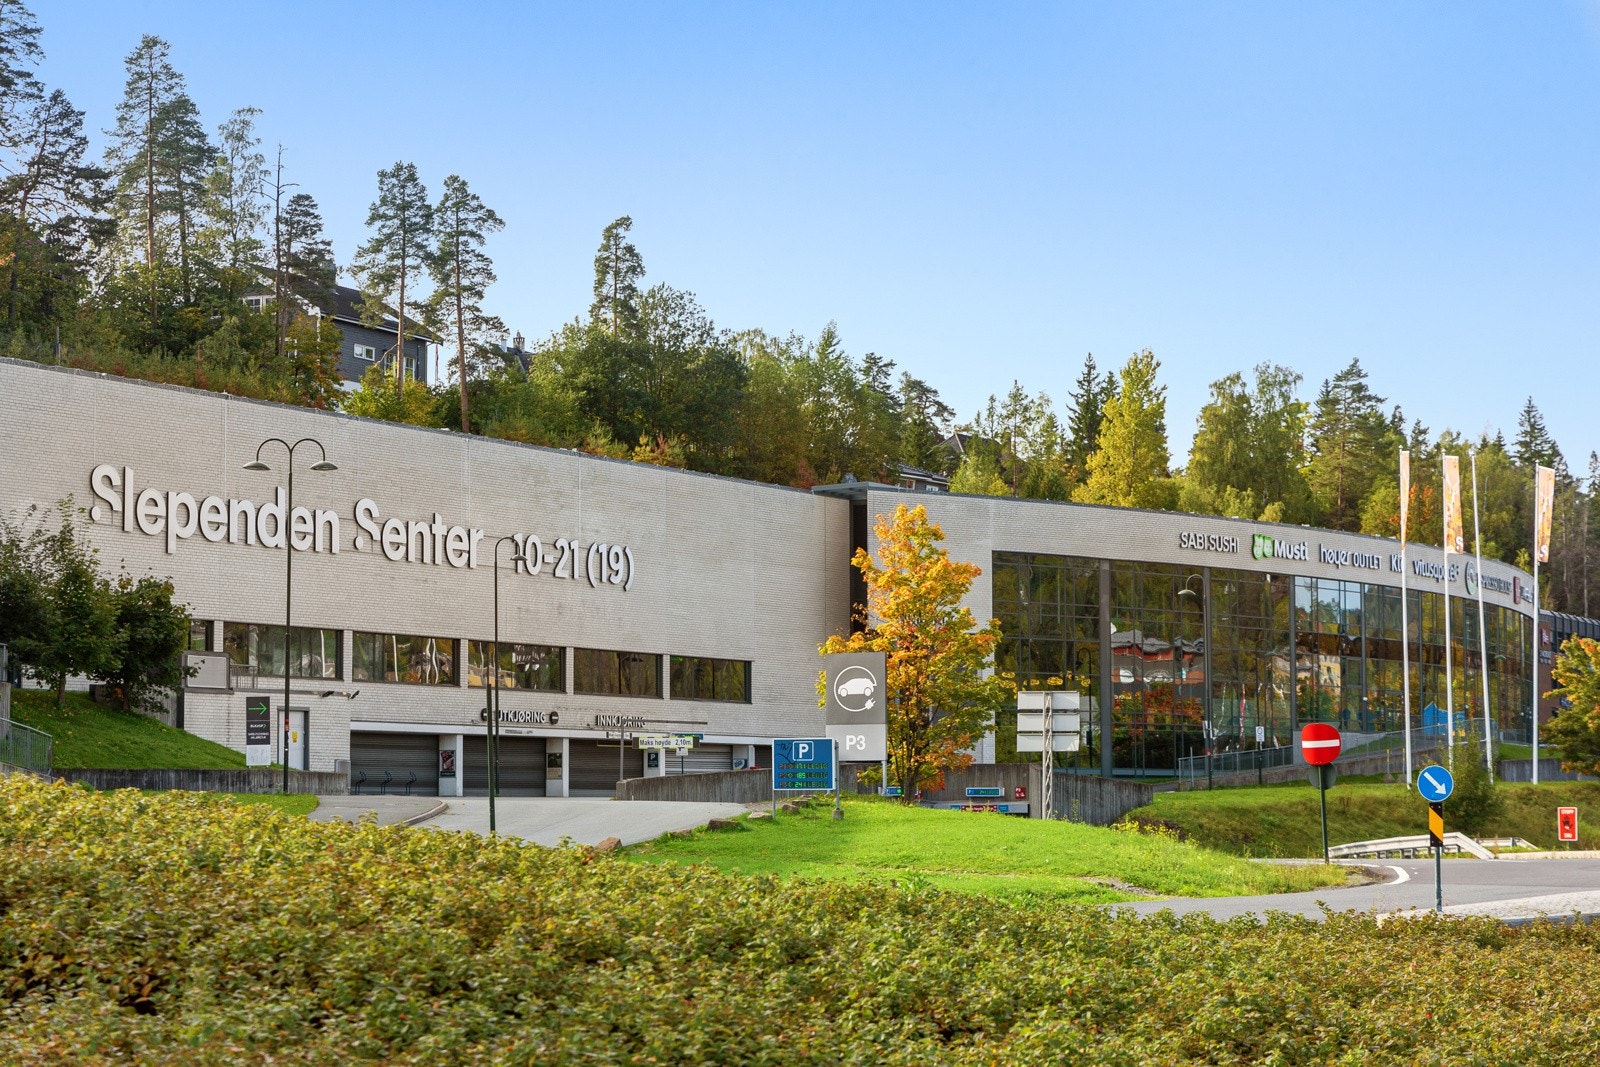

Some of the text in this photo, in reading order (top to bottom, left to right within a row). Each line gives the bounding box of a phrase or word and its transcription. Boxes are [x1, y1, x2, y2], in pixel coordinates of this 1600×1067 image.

[91, 464, 635, 592] Slependen Senter 10-21 (19)
[1273, 539, 1309, 561] Musti
[1319, 543, 1382, 570] høyer OUTLET
[655, 739, 672, 747] høyde
[799, 743, 809, 758] P
[845, 734, 866, 750] P3
